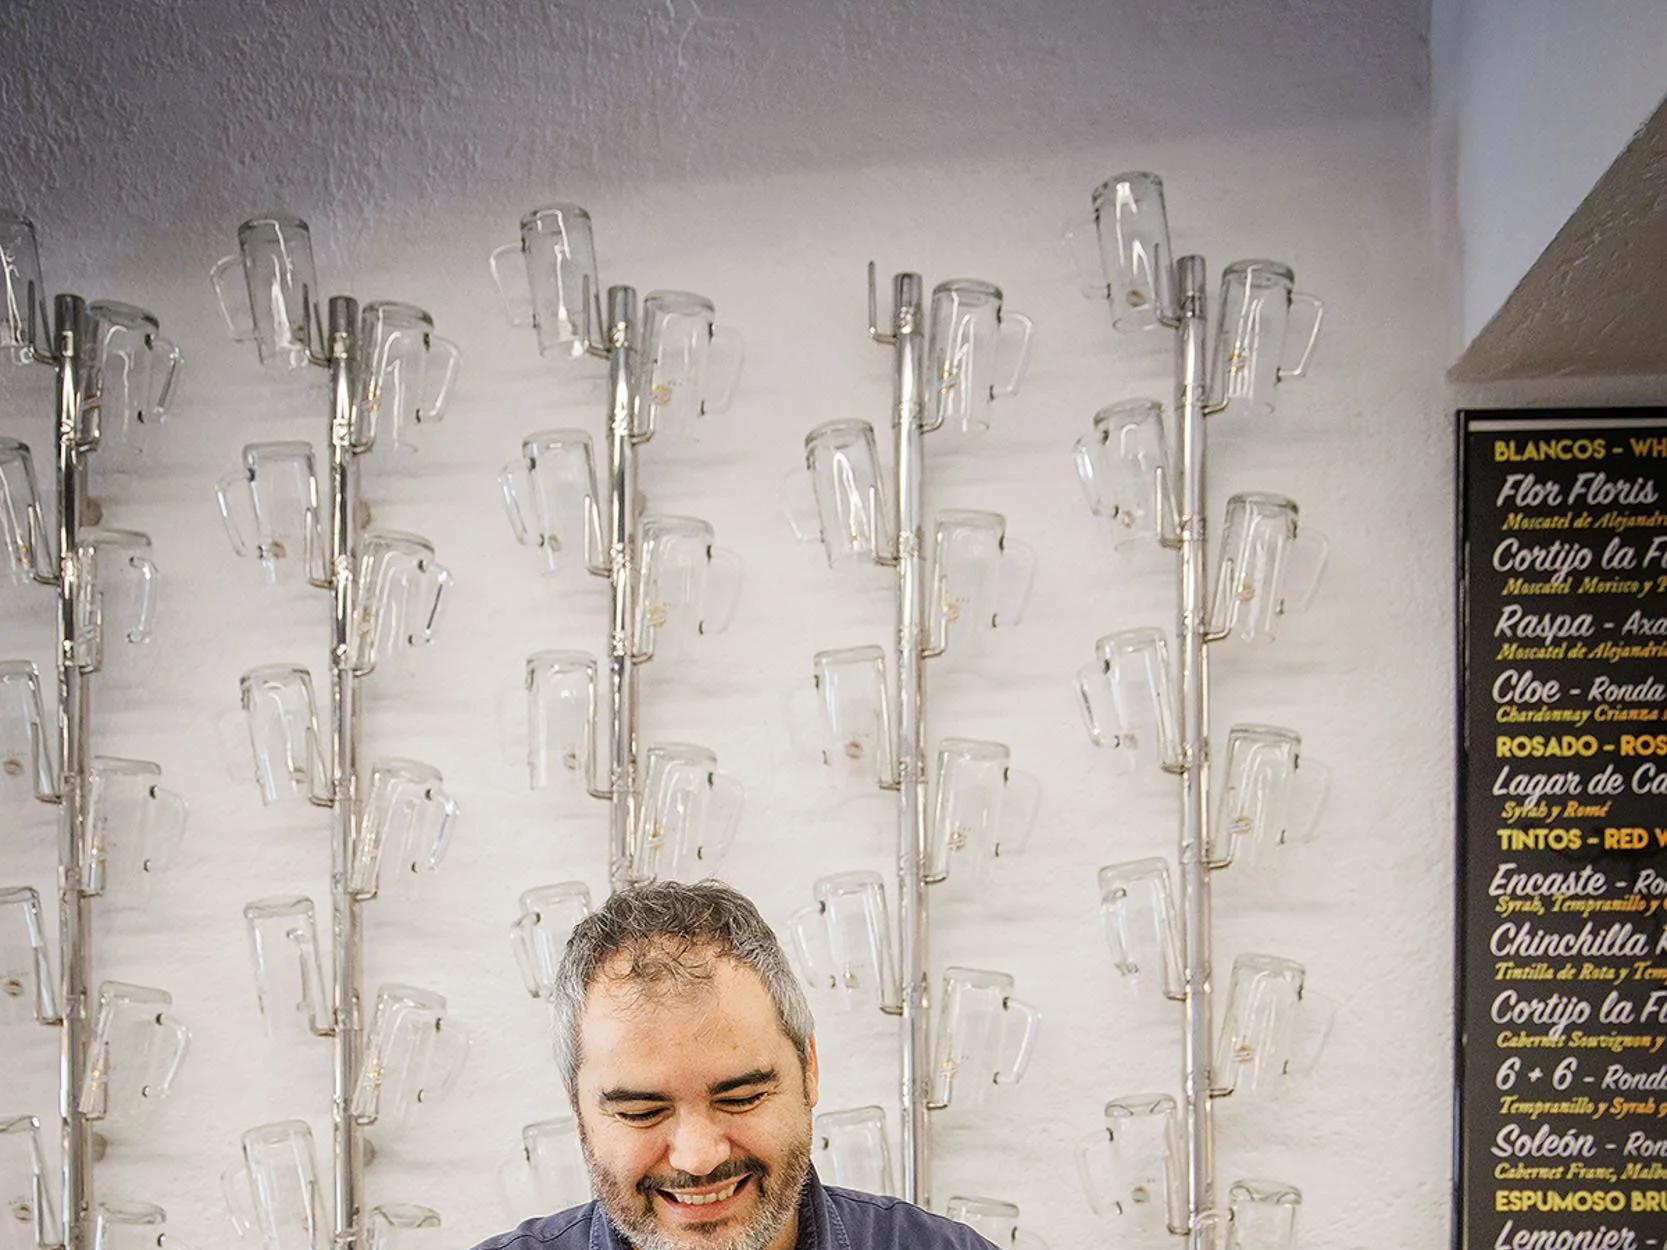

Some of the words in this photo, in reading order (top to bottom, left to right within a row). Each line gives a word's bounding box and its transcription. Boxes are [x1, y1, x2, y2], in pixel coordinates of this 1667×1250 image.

[1493, 439, 1606, 462] BLANCOS
[1496, 472, 1563, 507] Flor
[1567, 471, 1659, 506] Floris
[1501, 511, 1573, 531] Moscatel
[1573, 512, 1593, 528] de
[1492, 536, 1593, 585] Cortijo
[1601, 536, 1637, 569] la
[1637, 582, 1654, 599] y
[1494, 604, 1595, 646] Raspa
[1496, 642, 1568, 661] Moscatel
[1567, 642, 1587, 659] de
[1492, 669, 1561, 704] Cloe
[1587, 675, 1666, 702] Ronda
[1496, 705, 1592, 727] Chardonnay
[1496, 735, 1598, 758] ROSADO
[1492, 764, 1583, 808] Lagar
[1587, 764, 1625, 796] de
[1545, 805, 1562, 823] y
[1497, 829, 1582, 850] TINTOS
[1604, 828, 1649, 849] RED
[1488, 861, 1607, 897] Encaste
[1644, 899, 1660, 917] y
[1489, 921, 1649, 957] Chinchilla
[1556, 963, 1577, 980] de
[1613, 968, 1630, 986] y
[1490, 989, 1592, 1041] Cortijo
[1599, 990, 1635, 1024] la
[1649, 1036, 1666, 1053] y
[1495, 1057, 1522, 1091] 6
[1552, 1057, 1578, 1091] 6
[1592, 1102, 1609, 1120] y
[1491, 1123, 1597, 1158] Soleón
[1495, 1190, 1626, 1212] ESPUMOSO
